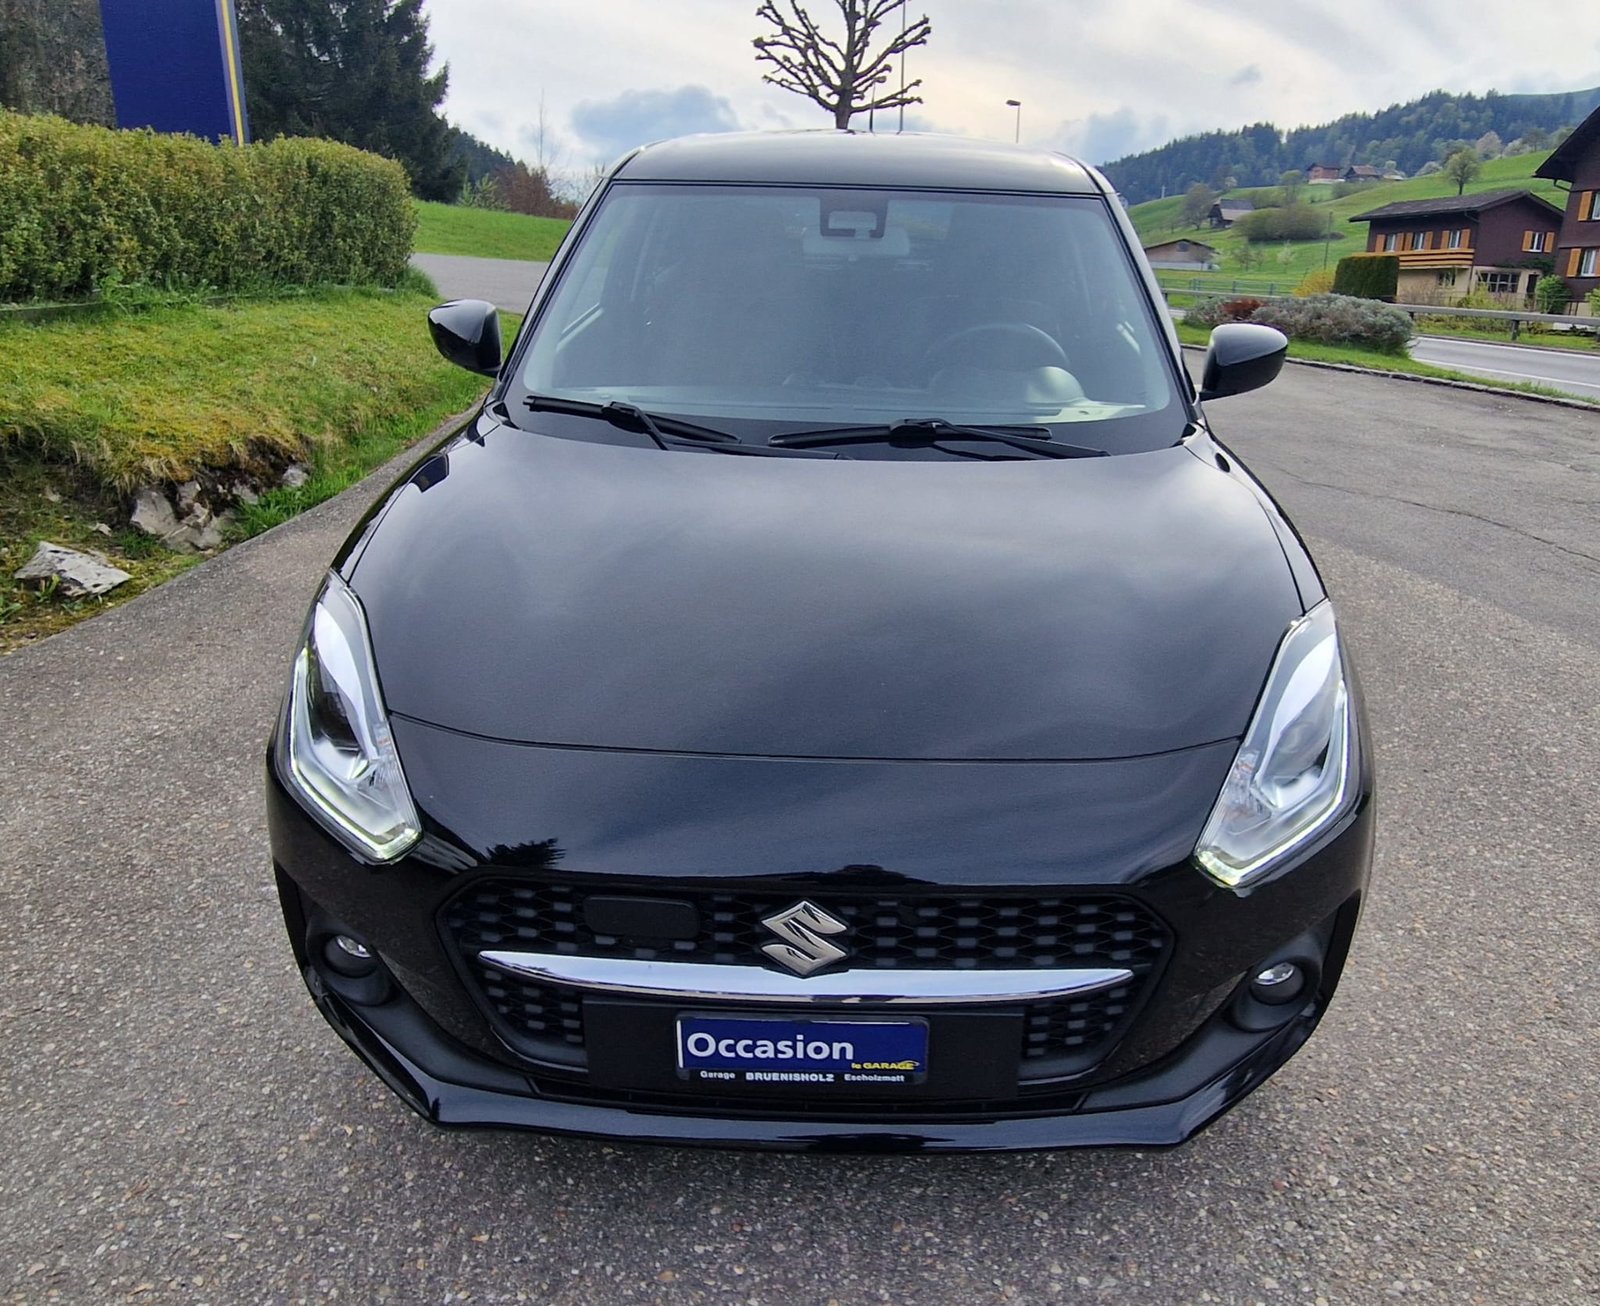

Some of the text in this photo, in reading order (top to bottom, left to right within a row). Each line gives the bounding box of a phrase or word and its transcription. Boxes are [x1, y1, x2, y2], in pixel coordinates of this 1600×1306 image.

[686, 1032, 854, 1061] Occasion
[863, 1061, 915, 1070] GARAGE
[700, 1070, 905, 1082] Garage BRUENISHOLZ Escholzmatt
